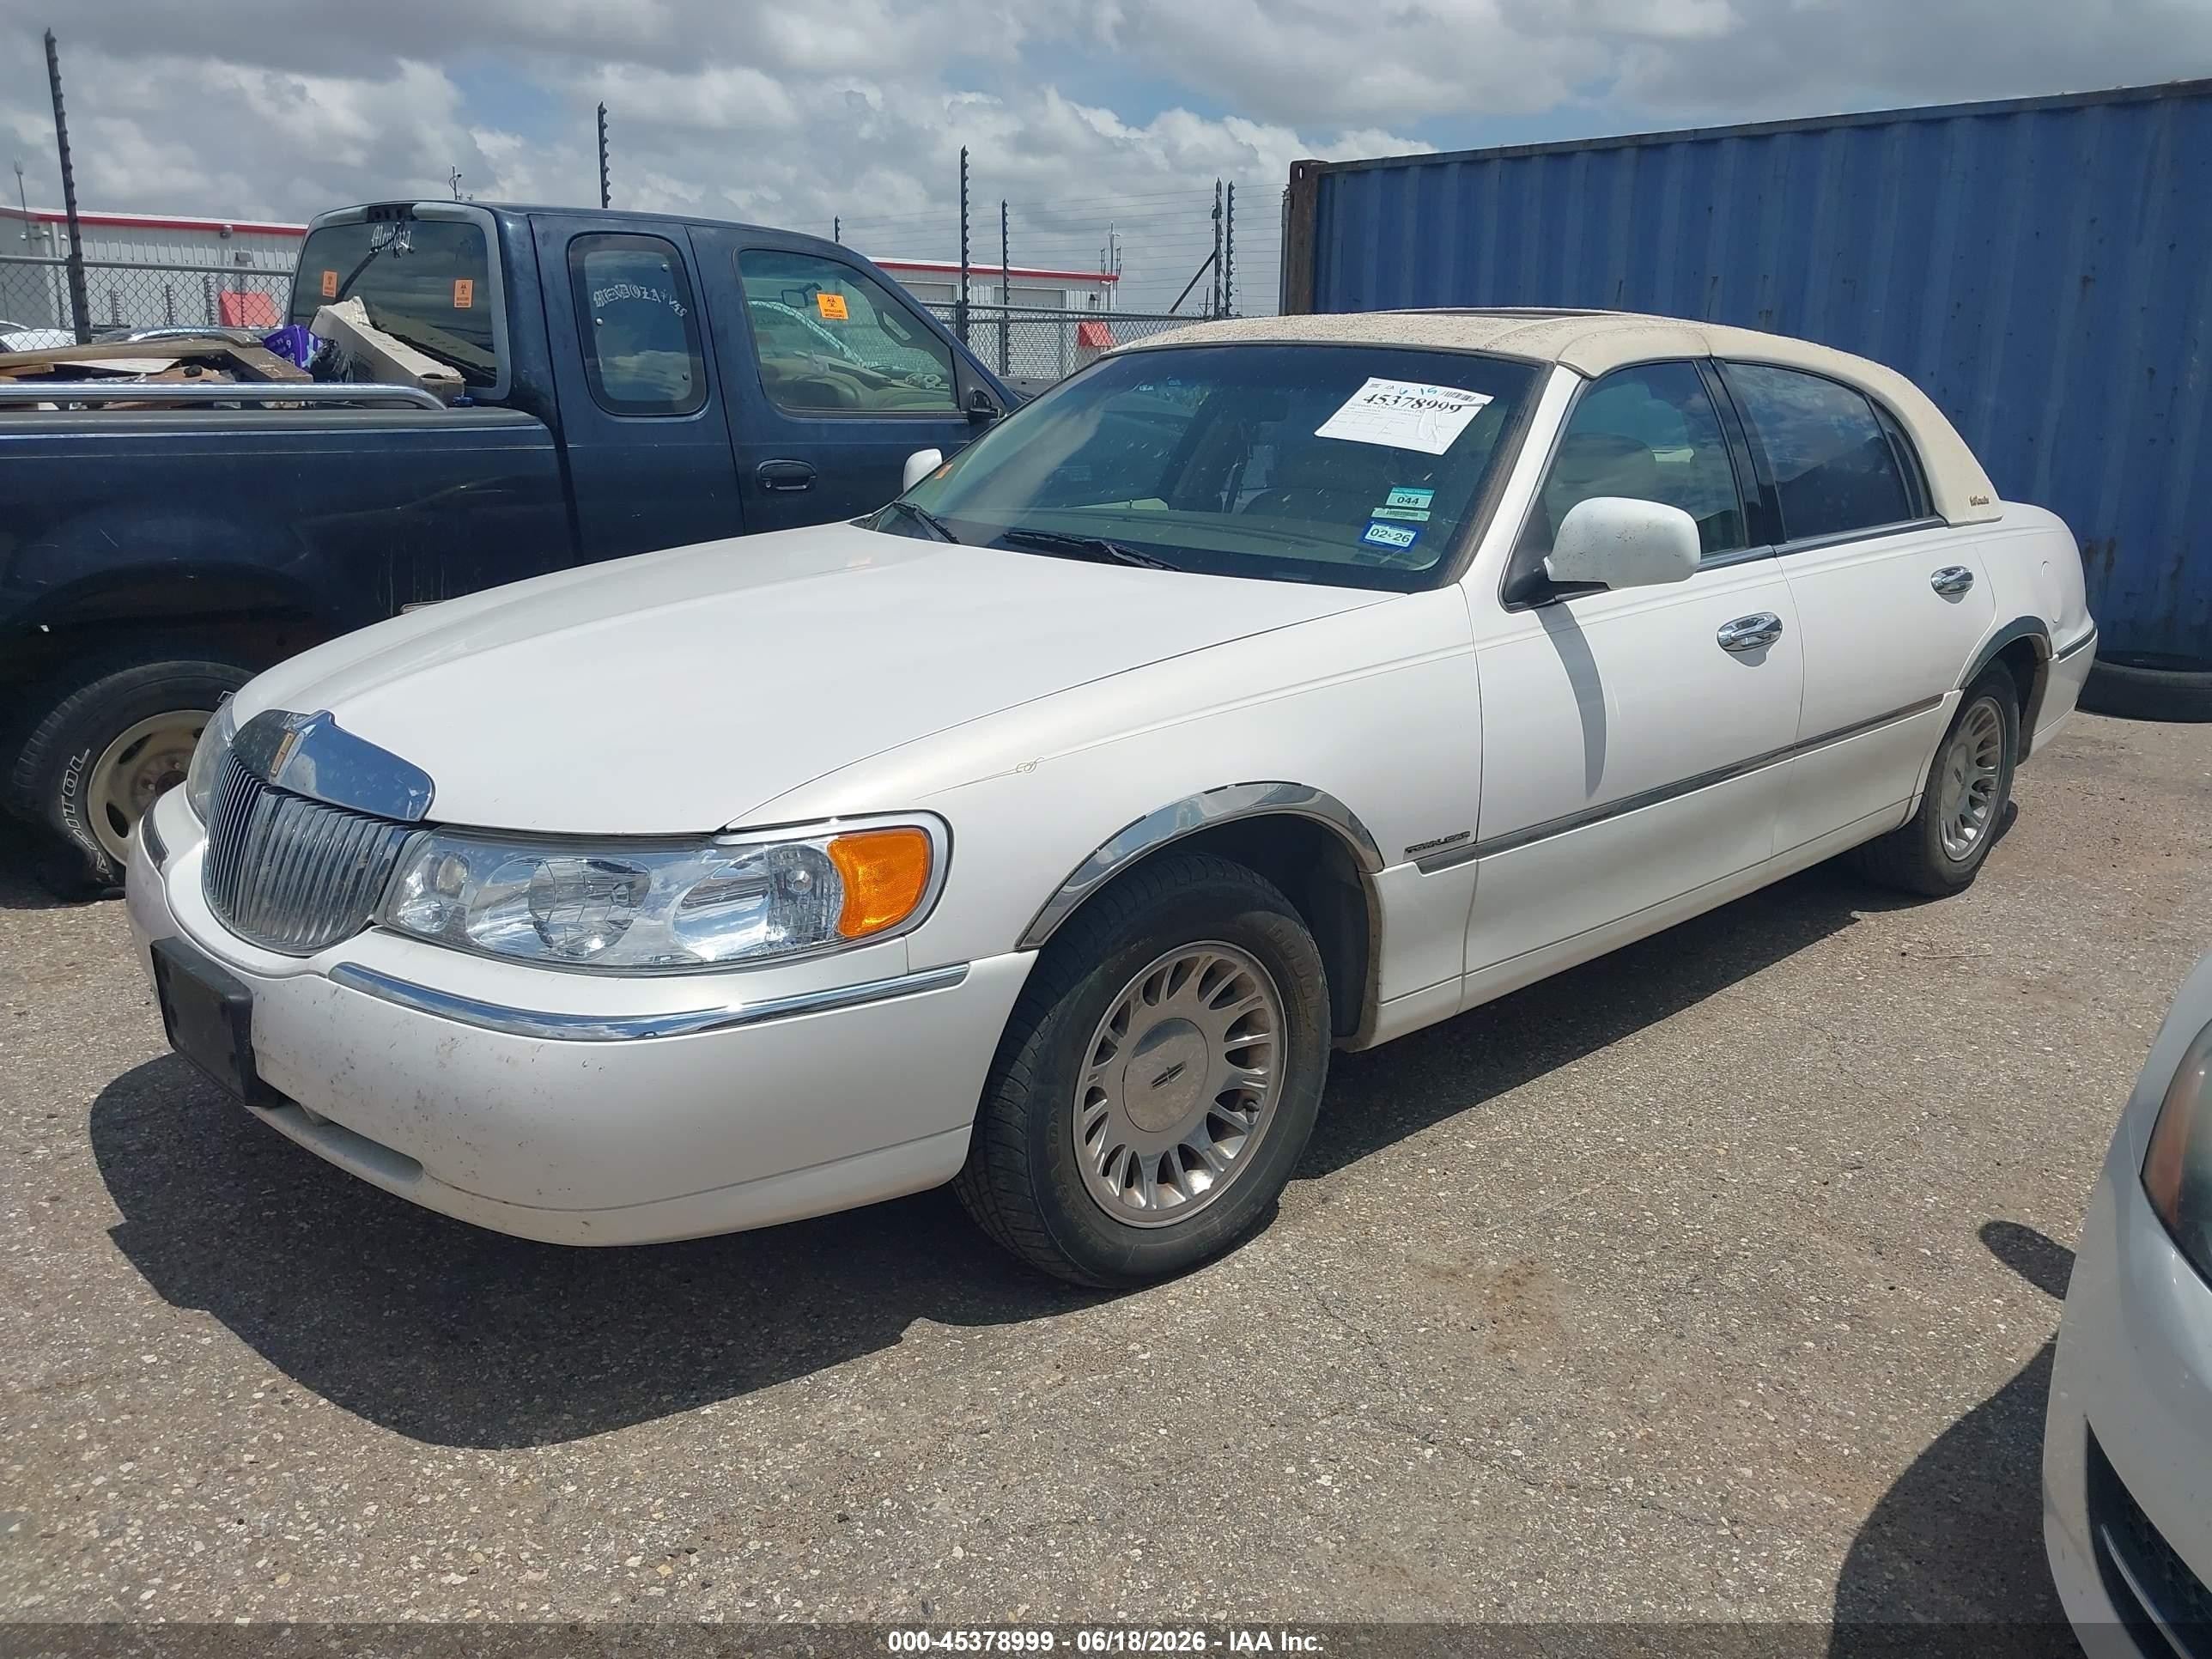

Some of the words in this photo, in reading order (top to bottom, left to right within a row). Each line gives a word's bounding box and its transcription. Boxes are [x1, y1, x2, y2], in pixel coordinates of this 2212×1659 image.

[592, 283, 661, 307] MENDOZA
[1363, 393, 1462, 414] 45378999
[1397, 496, 1419, 505] 044
